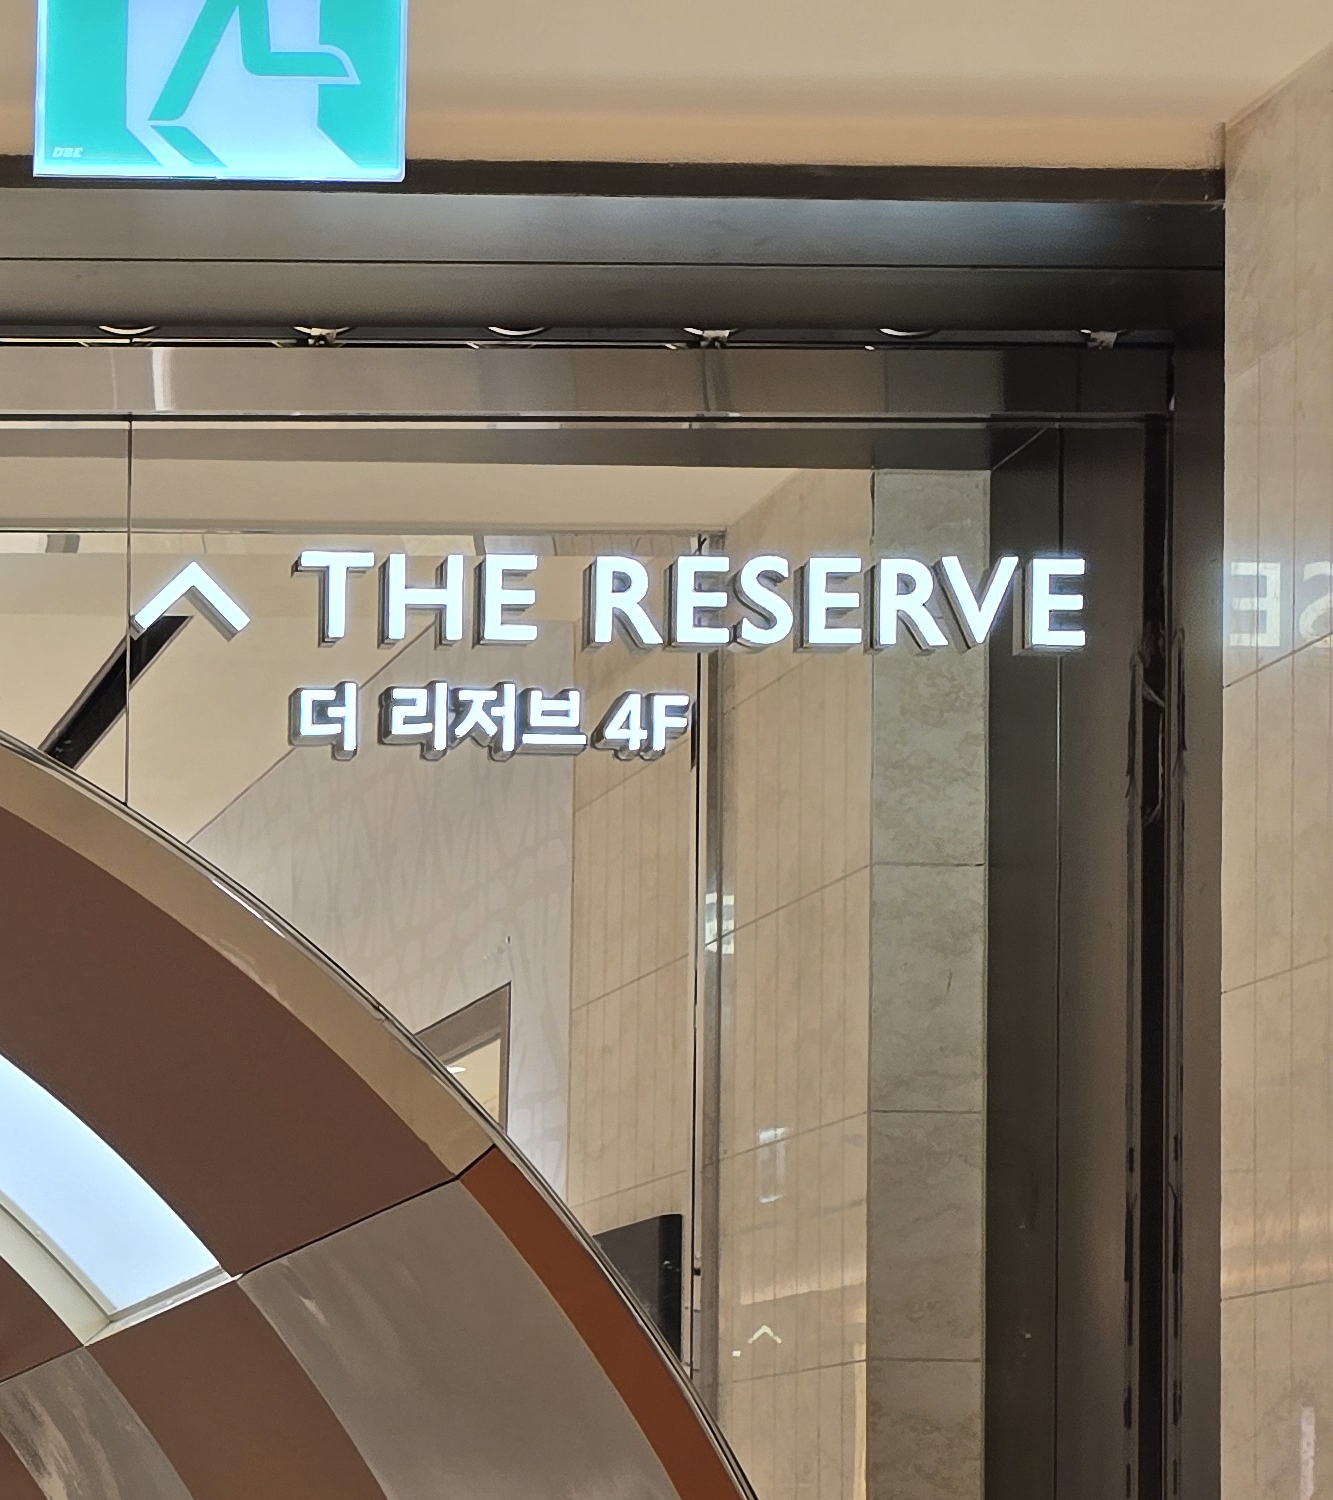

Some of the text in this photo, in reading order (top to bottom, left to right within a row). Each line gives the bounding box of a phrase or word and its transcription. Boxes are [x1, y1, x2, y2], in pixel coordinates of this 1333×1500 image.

[299, 550, 1088, 648] THE RESERVE
[299, 681, 691, 754] 더 리저브 4F
